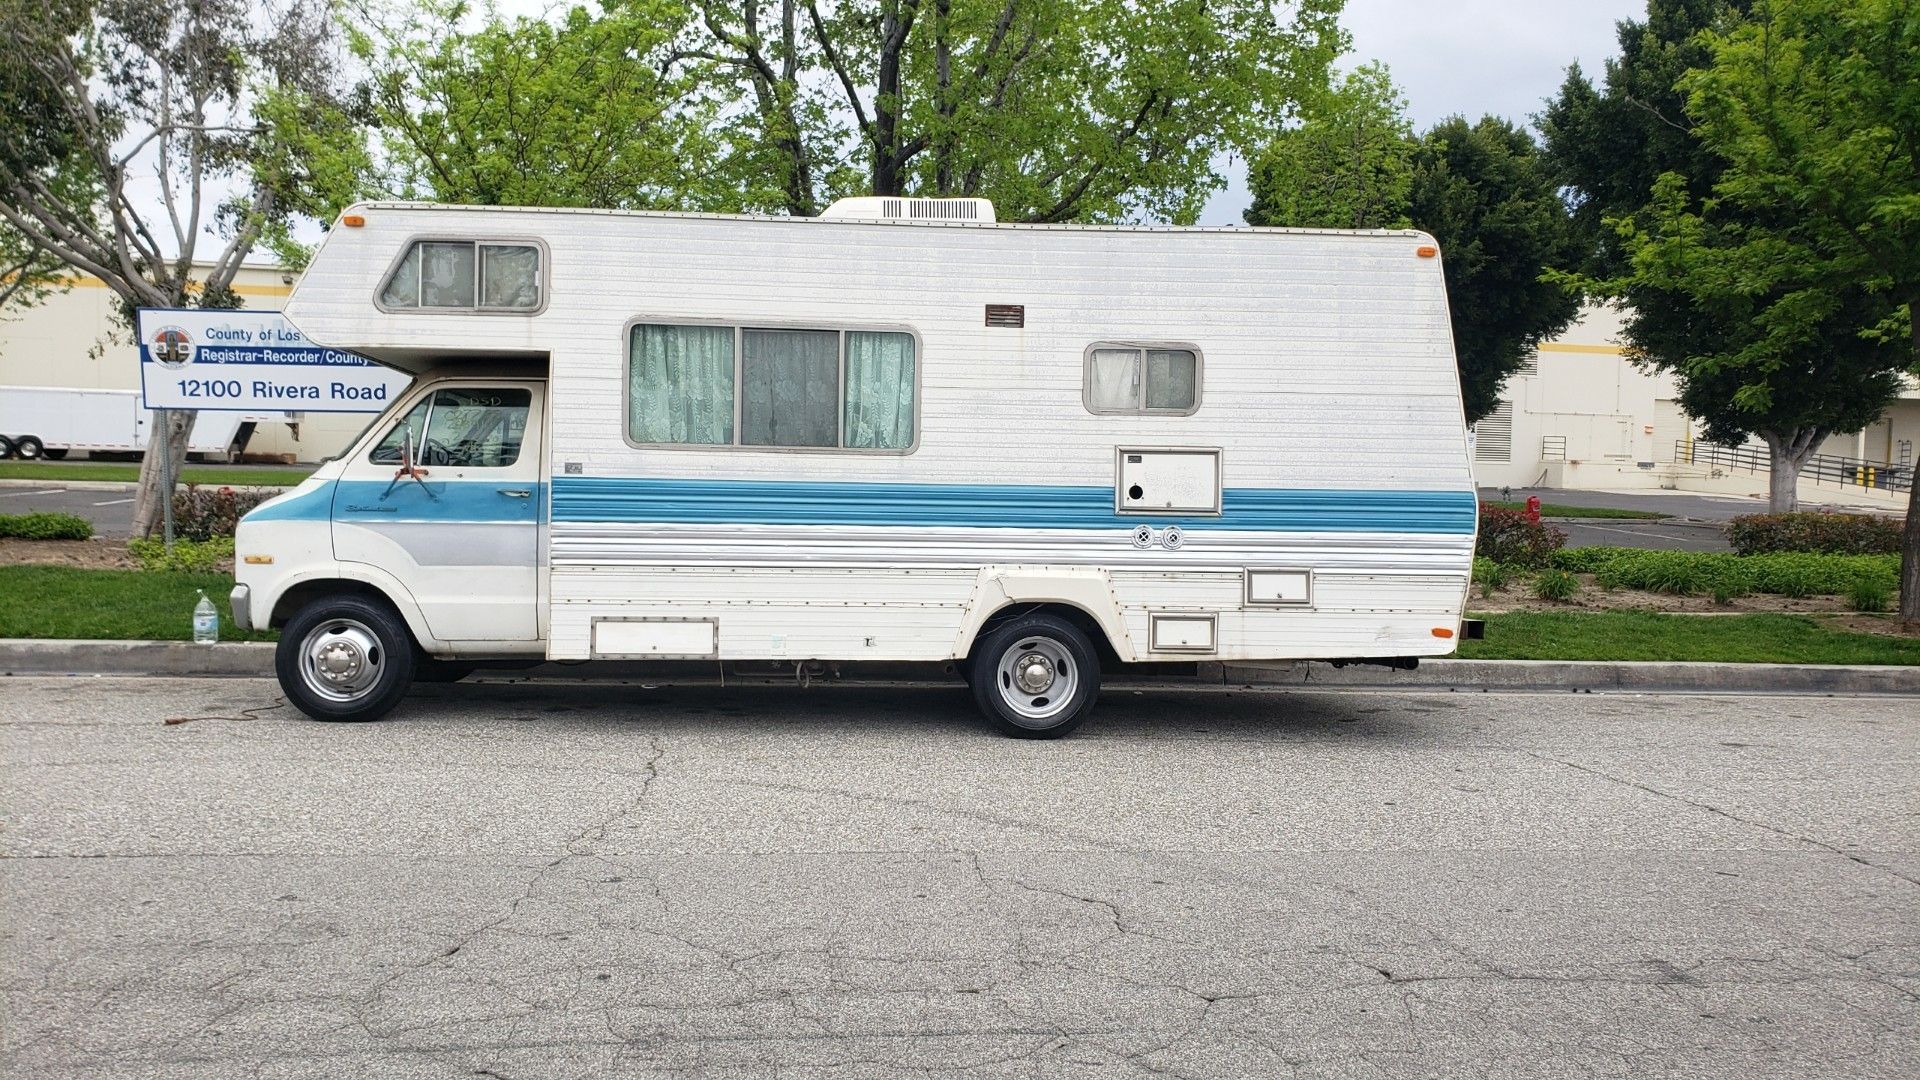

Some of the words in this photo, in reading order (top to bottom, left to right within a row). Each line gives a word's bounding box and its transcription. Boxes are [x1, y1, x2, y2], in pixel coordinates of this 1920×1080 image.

[205, 327, 253, 343] County
[259, 328, 272, 340] of
[277, 329, 300, 341] Los
[177, 379, 242, 398] 12100
[252, 380, 320, 399] Rivera
[330, 382, 387, 401] Road
